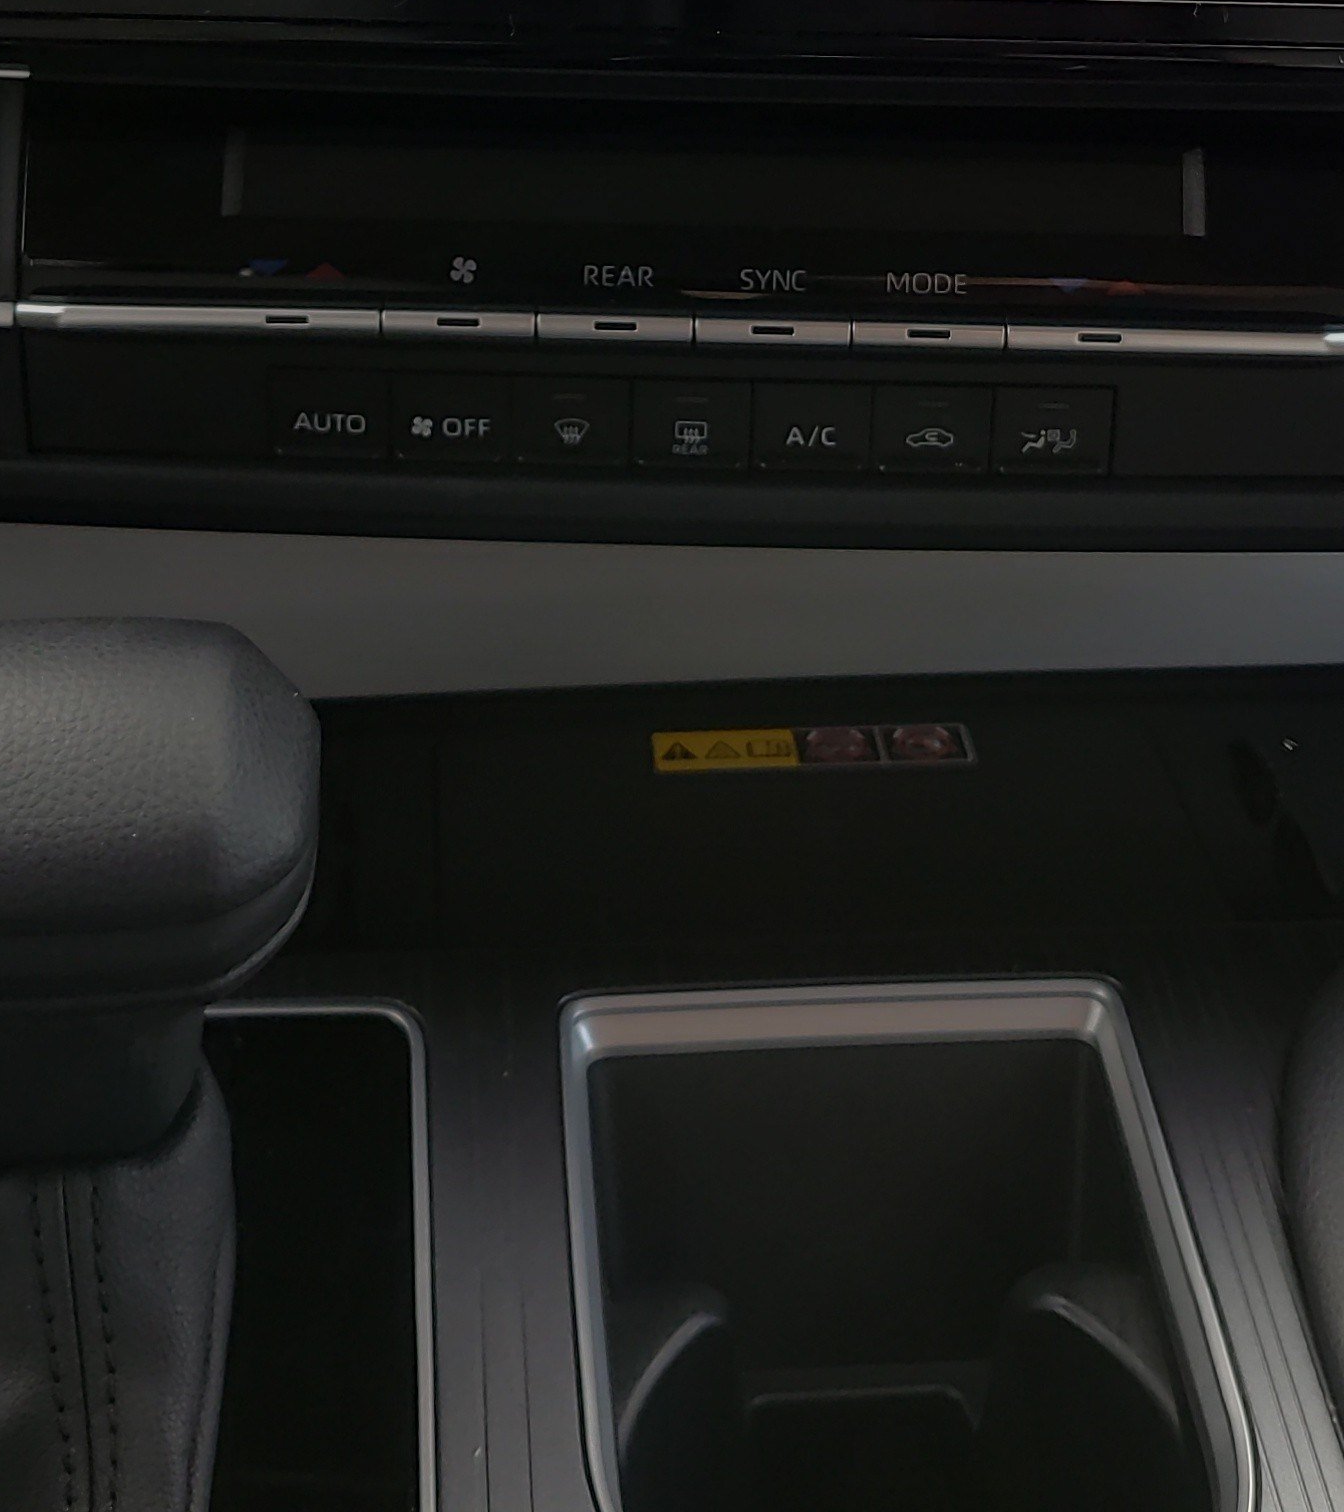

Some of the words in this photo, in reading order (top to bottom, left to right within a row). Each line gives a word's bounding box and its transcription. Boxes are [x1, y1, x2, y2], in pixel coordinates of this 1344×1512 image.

[582, 264, 655, 288] REAR
[740, 268, 807, 292] SYNC
[885, 272, 968, 295] MODE
[292, 412, 367, 435] AUTO
[442, 416, 492, 438] OFF
[785, 425, 837, 448] A/C
[671, 443, 709, 456] REAR
